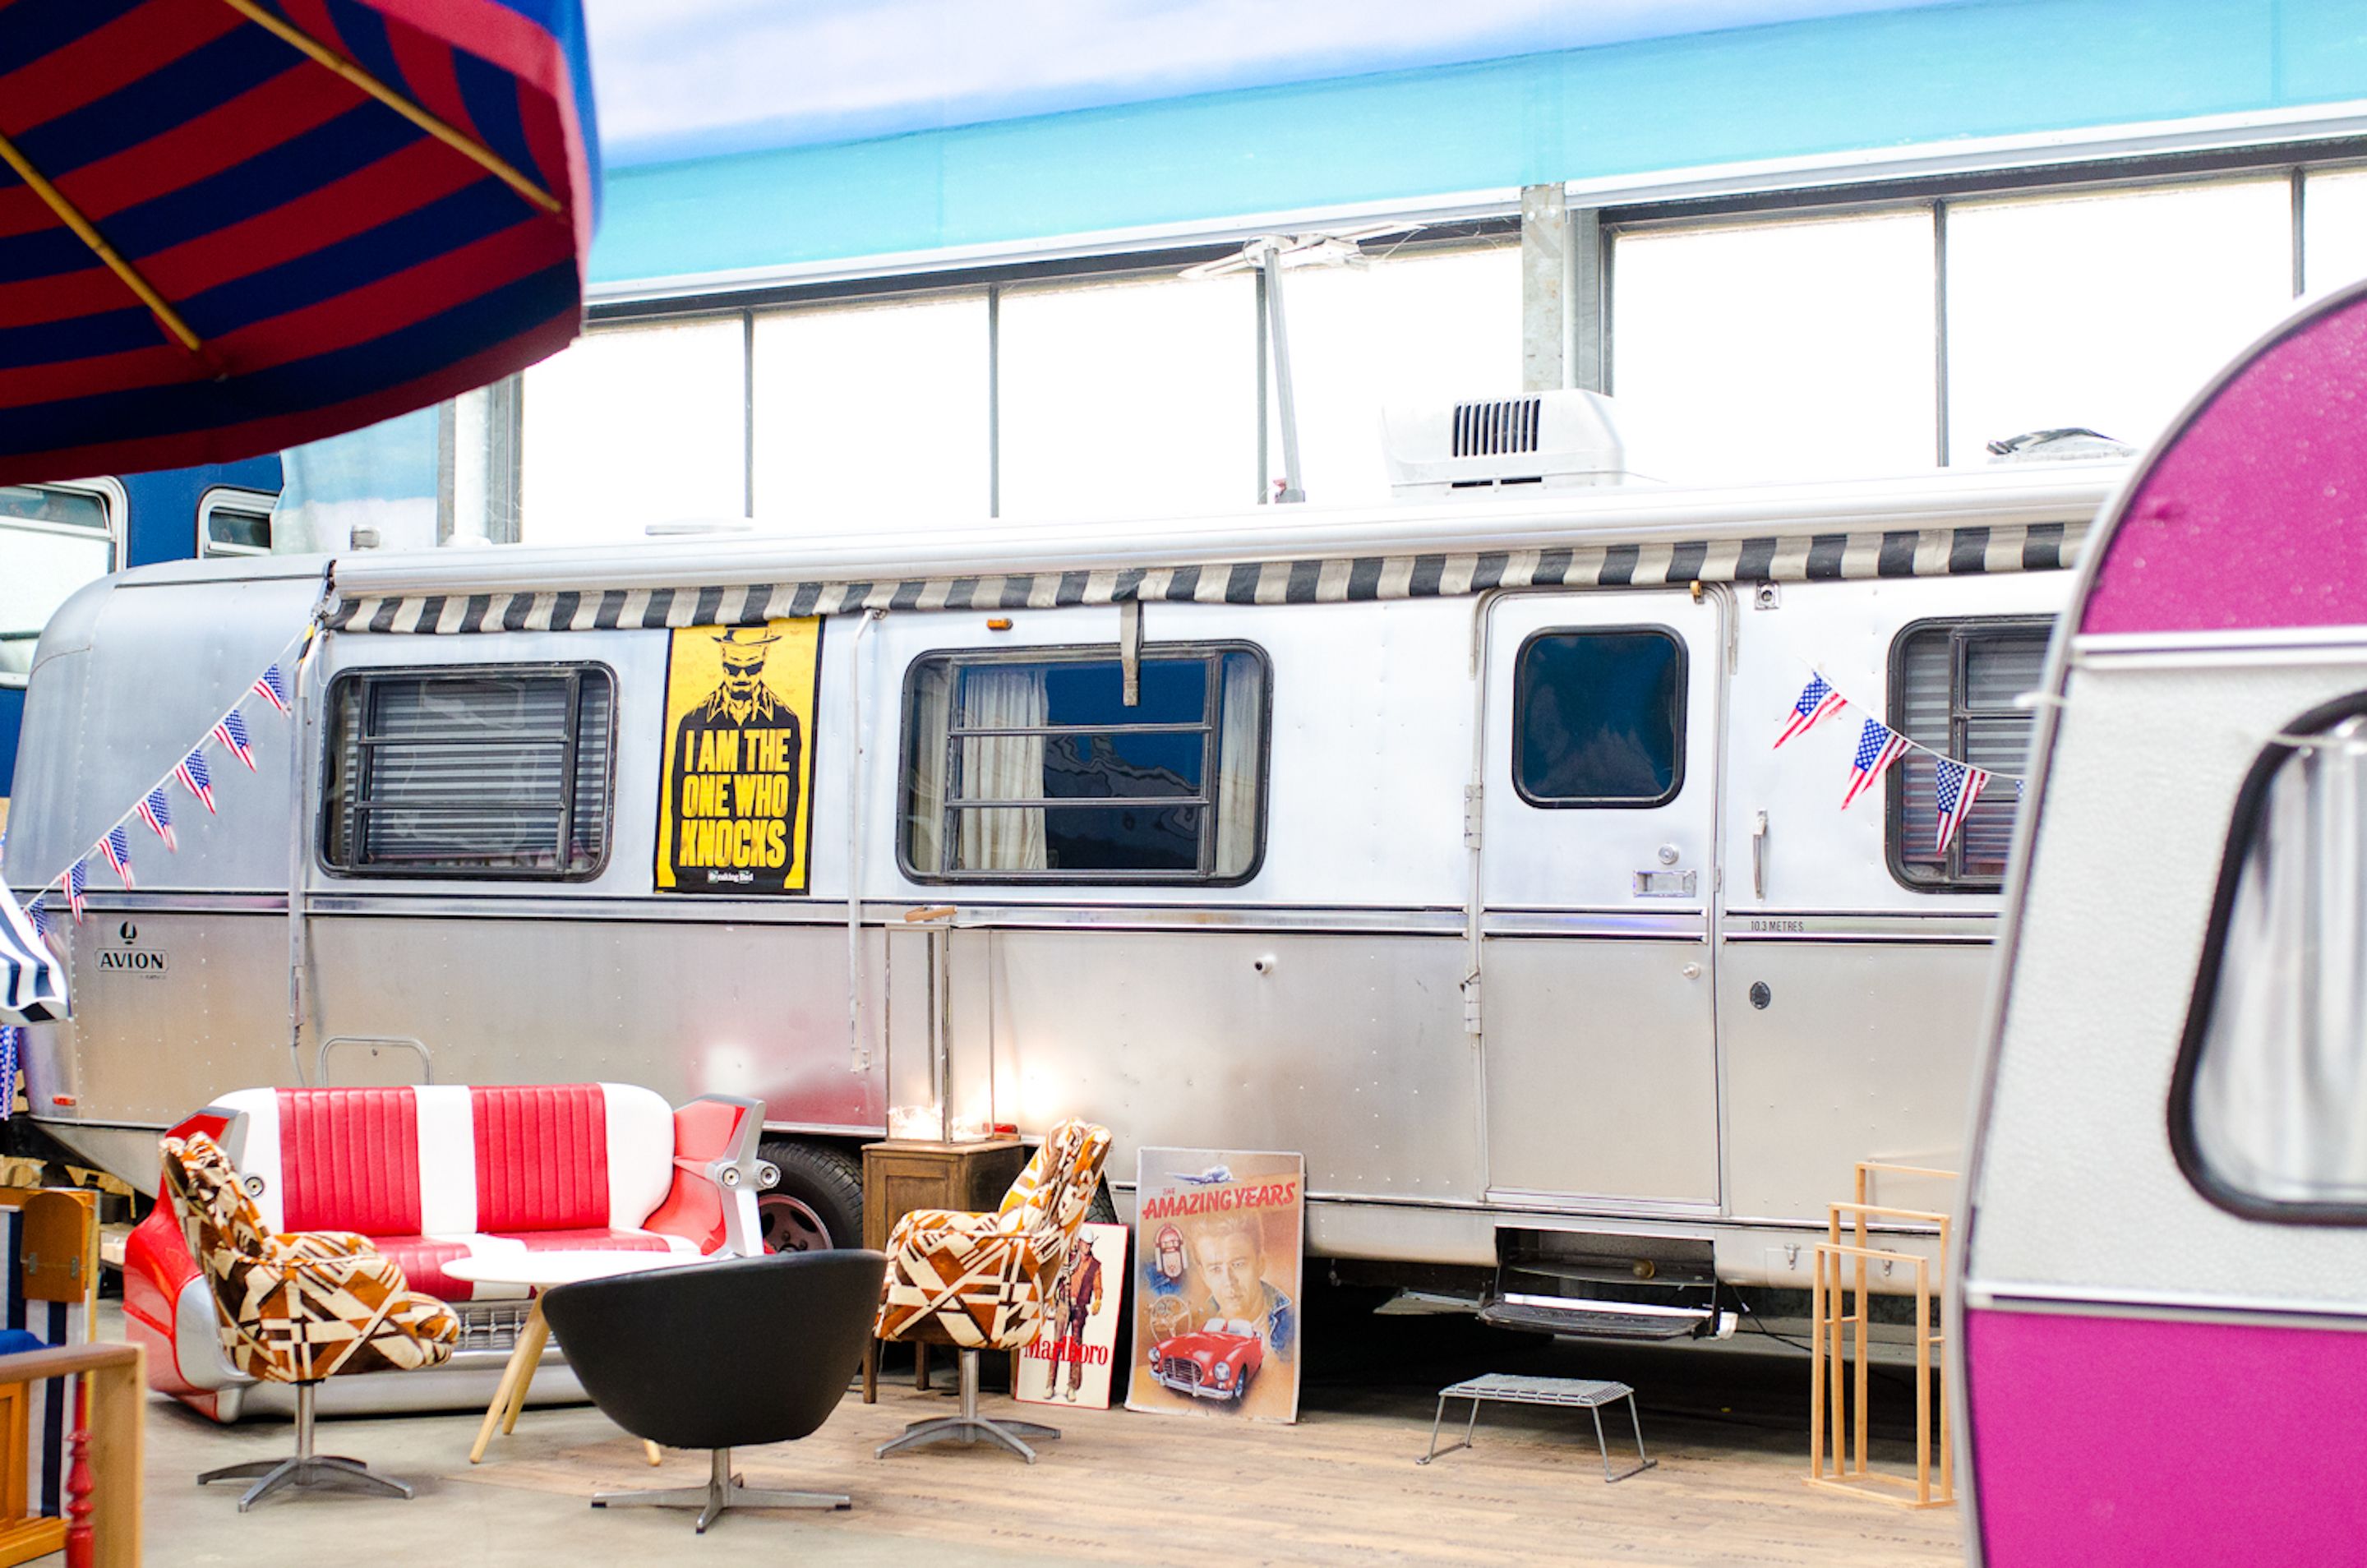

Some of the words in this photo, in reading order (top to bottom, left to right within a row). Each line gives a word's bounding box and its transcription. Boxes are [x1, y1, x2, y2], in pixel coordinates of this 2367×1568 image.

[684, 729, 695, 772] I
[697, 729, 740, 772] AM
[744, 728, 791, 772] THE
[681, 773, 731, 818] ONE
[733, 773, 790, 818] WHO
[679, 819, 787, 868] KNOCKS
[1751, 920, 1767, 931] 10.3
[1769, 920, 1805, 932] METRES
[100, 952, 164, 969] AVION
[1142, 1190, 1232, 1220] AMAZING
[1234, 1183, 1296, 1209] YEARS
[1024, 1334, 1109, 1366] Marlboro
